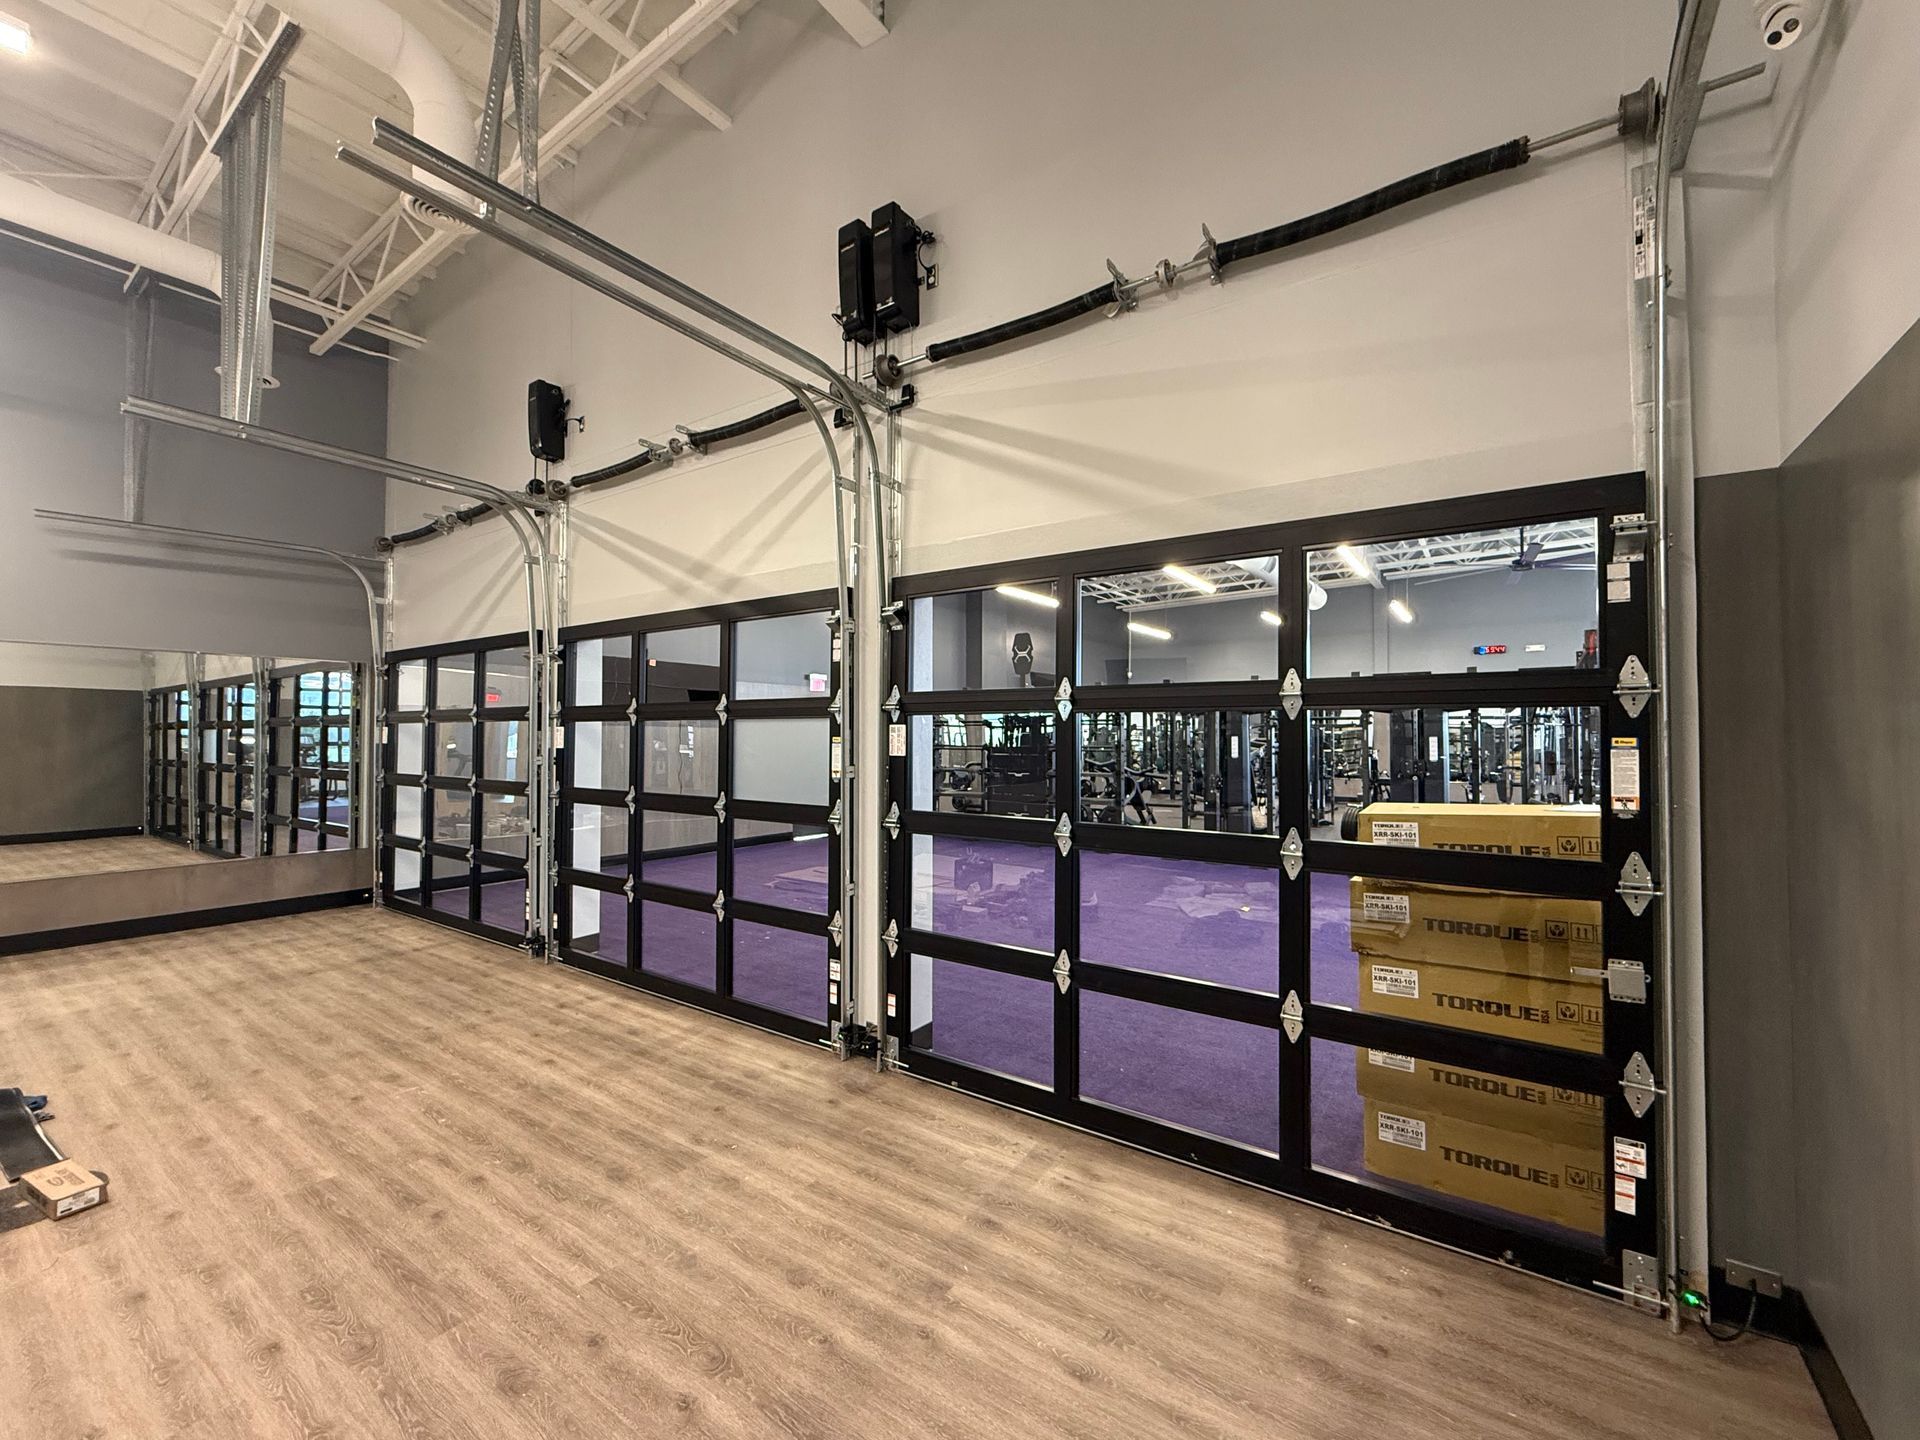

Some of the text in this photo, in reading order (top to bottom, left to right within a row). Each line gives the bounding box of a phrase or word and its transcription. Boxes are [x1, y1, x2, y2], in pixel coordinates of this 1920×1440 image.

[1422, 917, 1529, 942] TORQUE
[1432, 992, 1550, 1024] TORQUE USA
[1429, 1067, 1537, 1103] TORQUE
[1440, 1145, 1549, 1186] TORQUE
